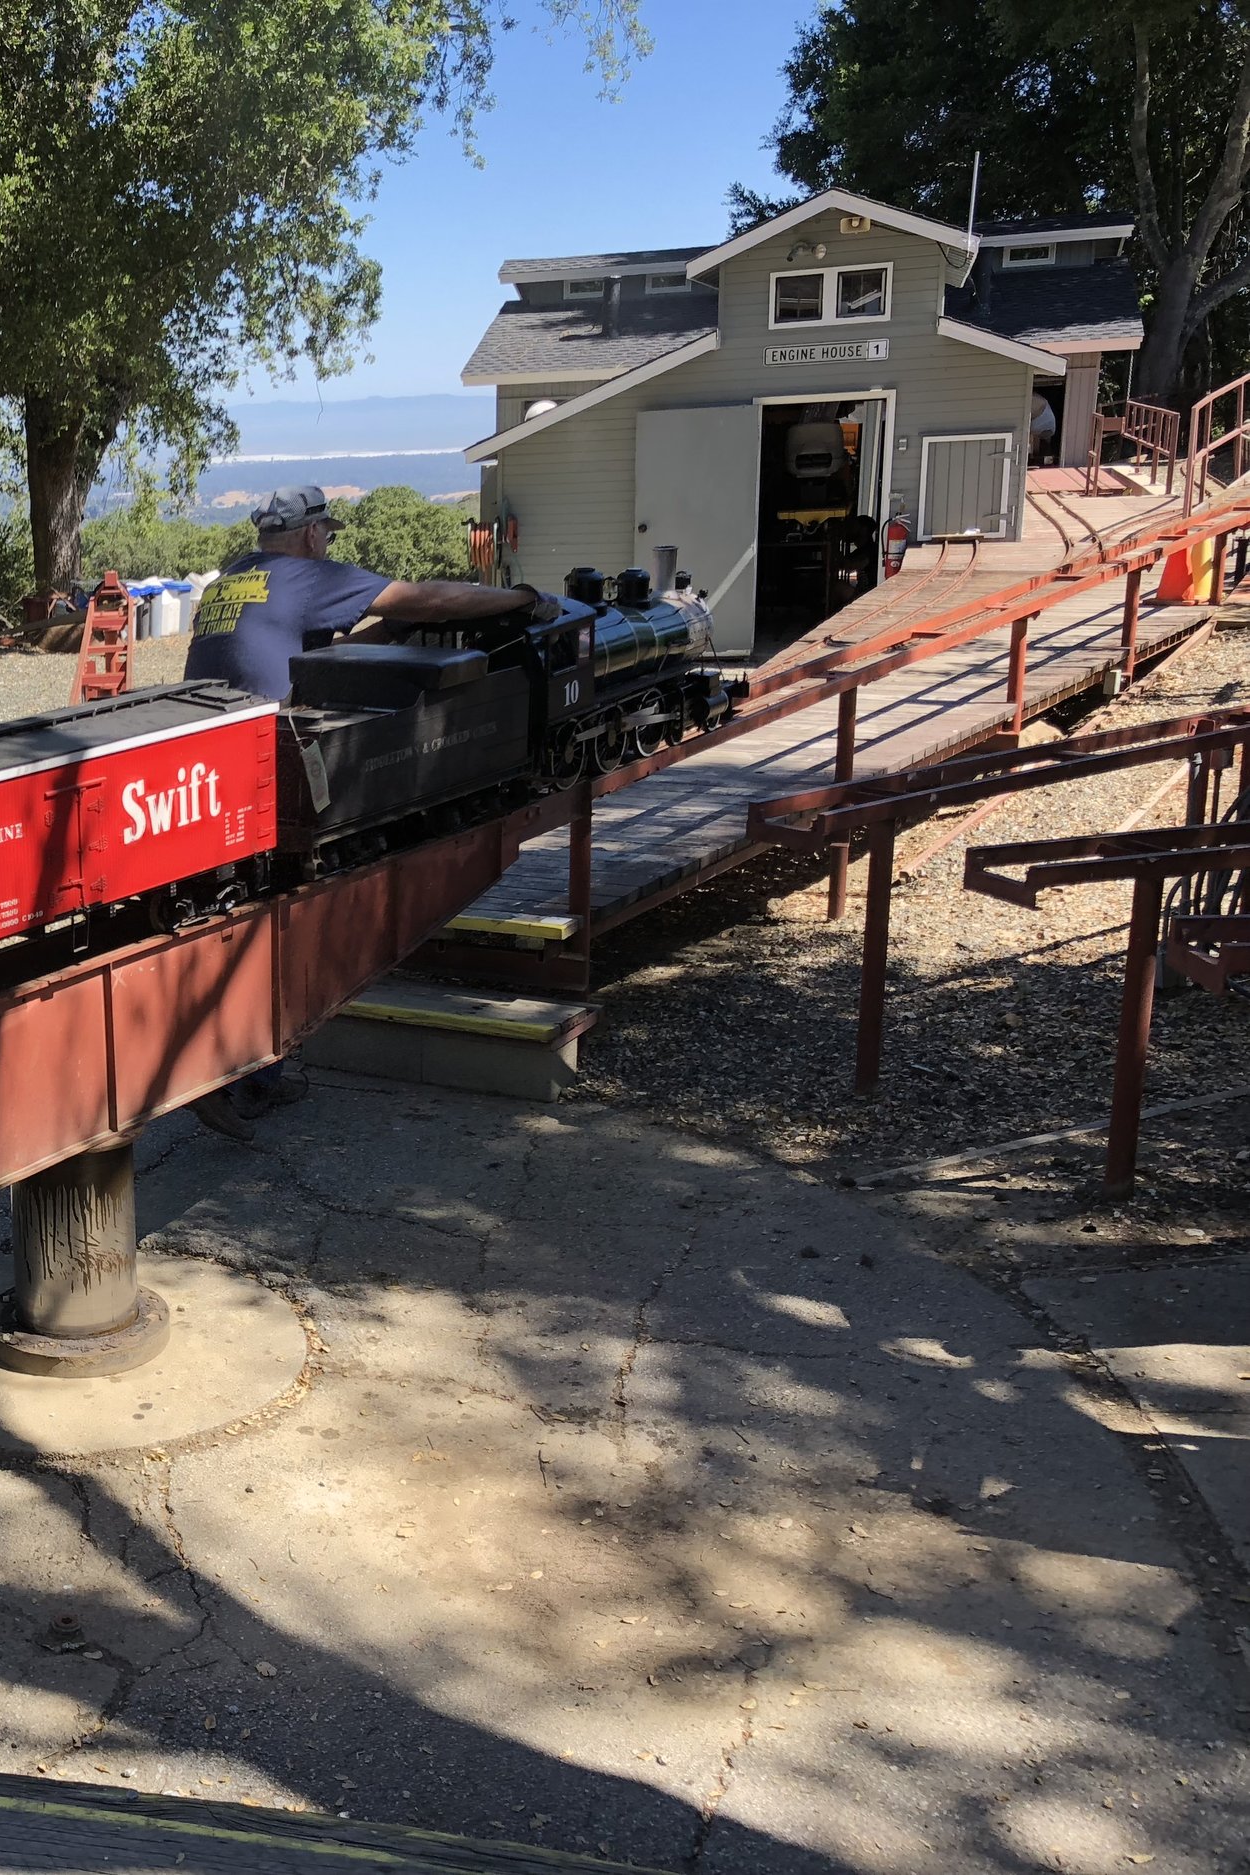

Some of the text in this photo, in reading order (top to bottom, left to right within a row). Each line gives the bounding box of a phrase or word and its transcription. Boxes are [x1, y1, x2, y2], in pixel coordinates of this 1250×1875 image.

[771, 344, 880, 362] ENGINE HOUSE 1
[564, 680, 579, 707] 10
[122, 762, 221, 845] Swift
